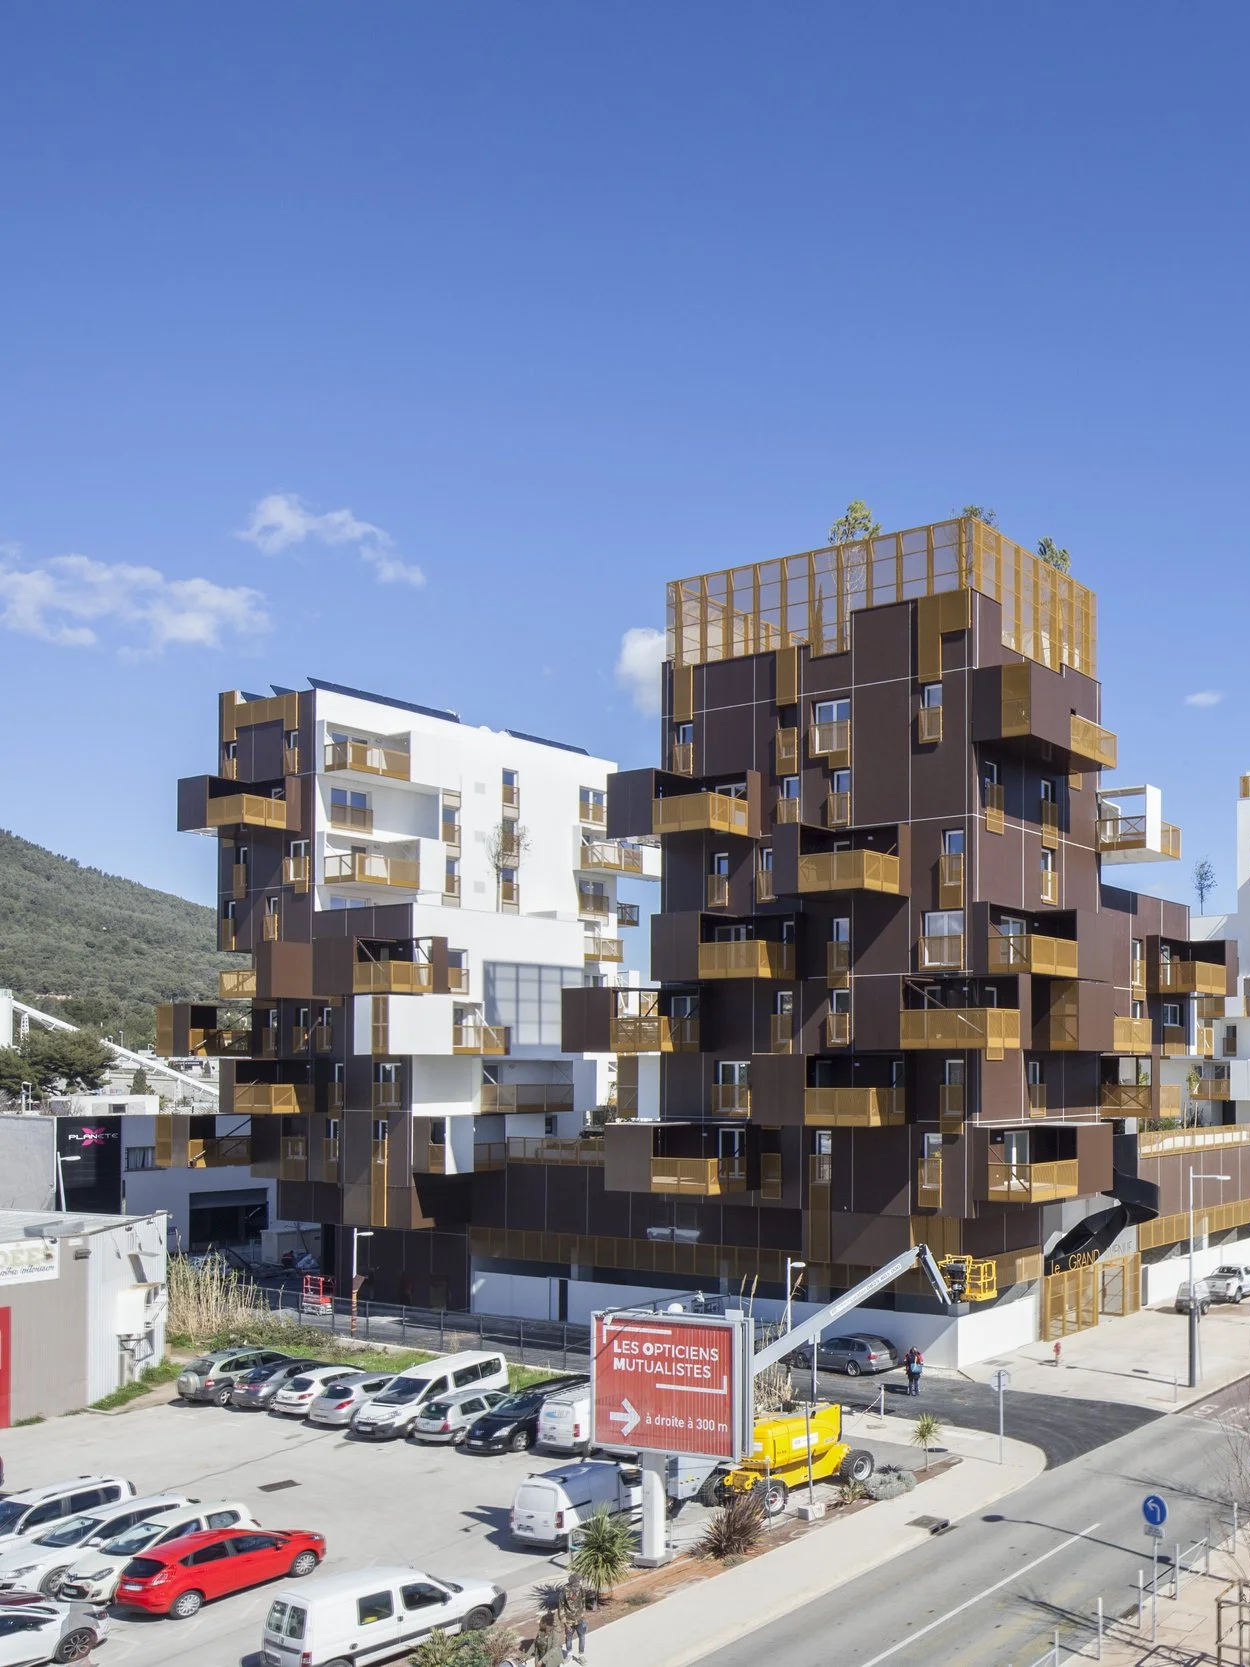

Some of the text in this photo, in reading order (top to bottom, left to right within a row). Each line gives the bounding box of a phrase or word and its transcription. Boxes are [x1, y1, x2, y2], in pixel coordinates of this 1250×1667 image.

[1068, 1248, 1100, 1270] GRAND
[613, 1339, 719, 1362] LES OPTICIENS
[613, 1357, 711, 1379] MUTUALISTES
[645, 1412, 728, 1432] à droite à 300 m
